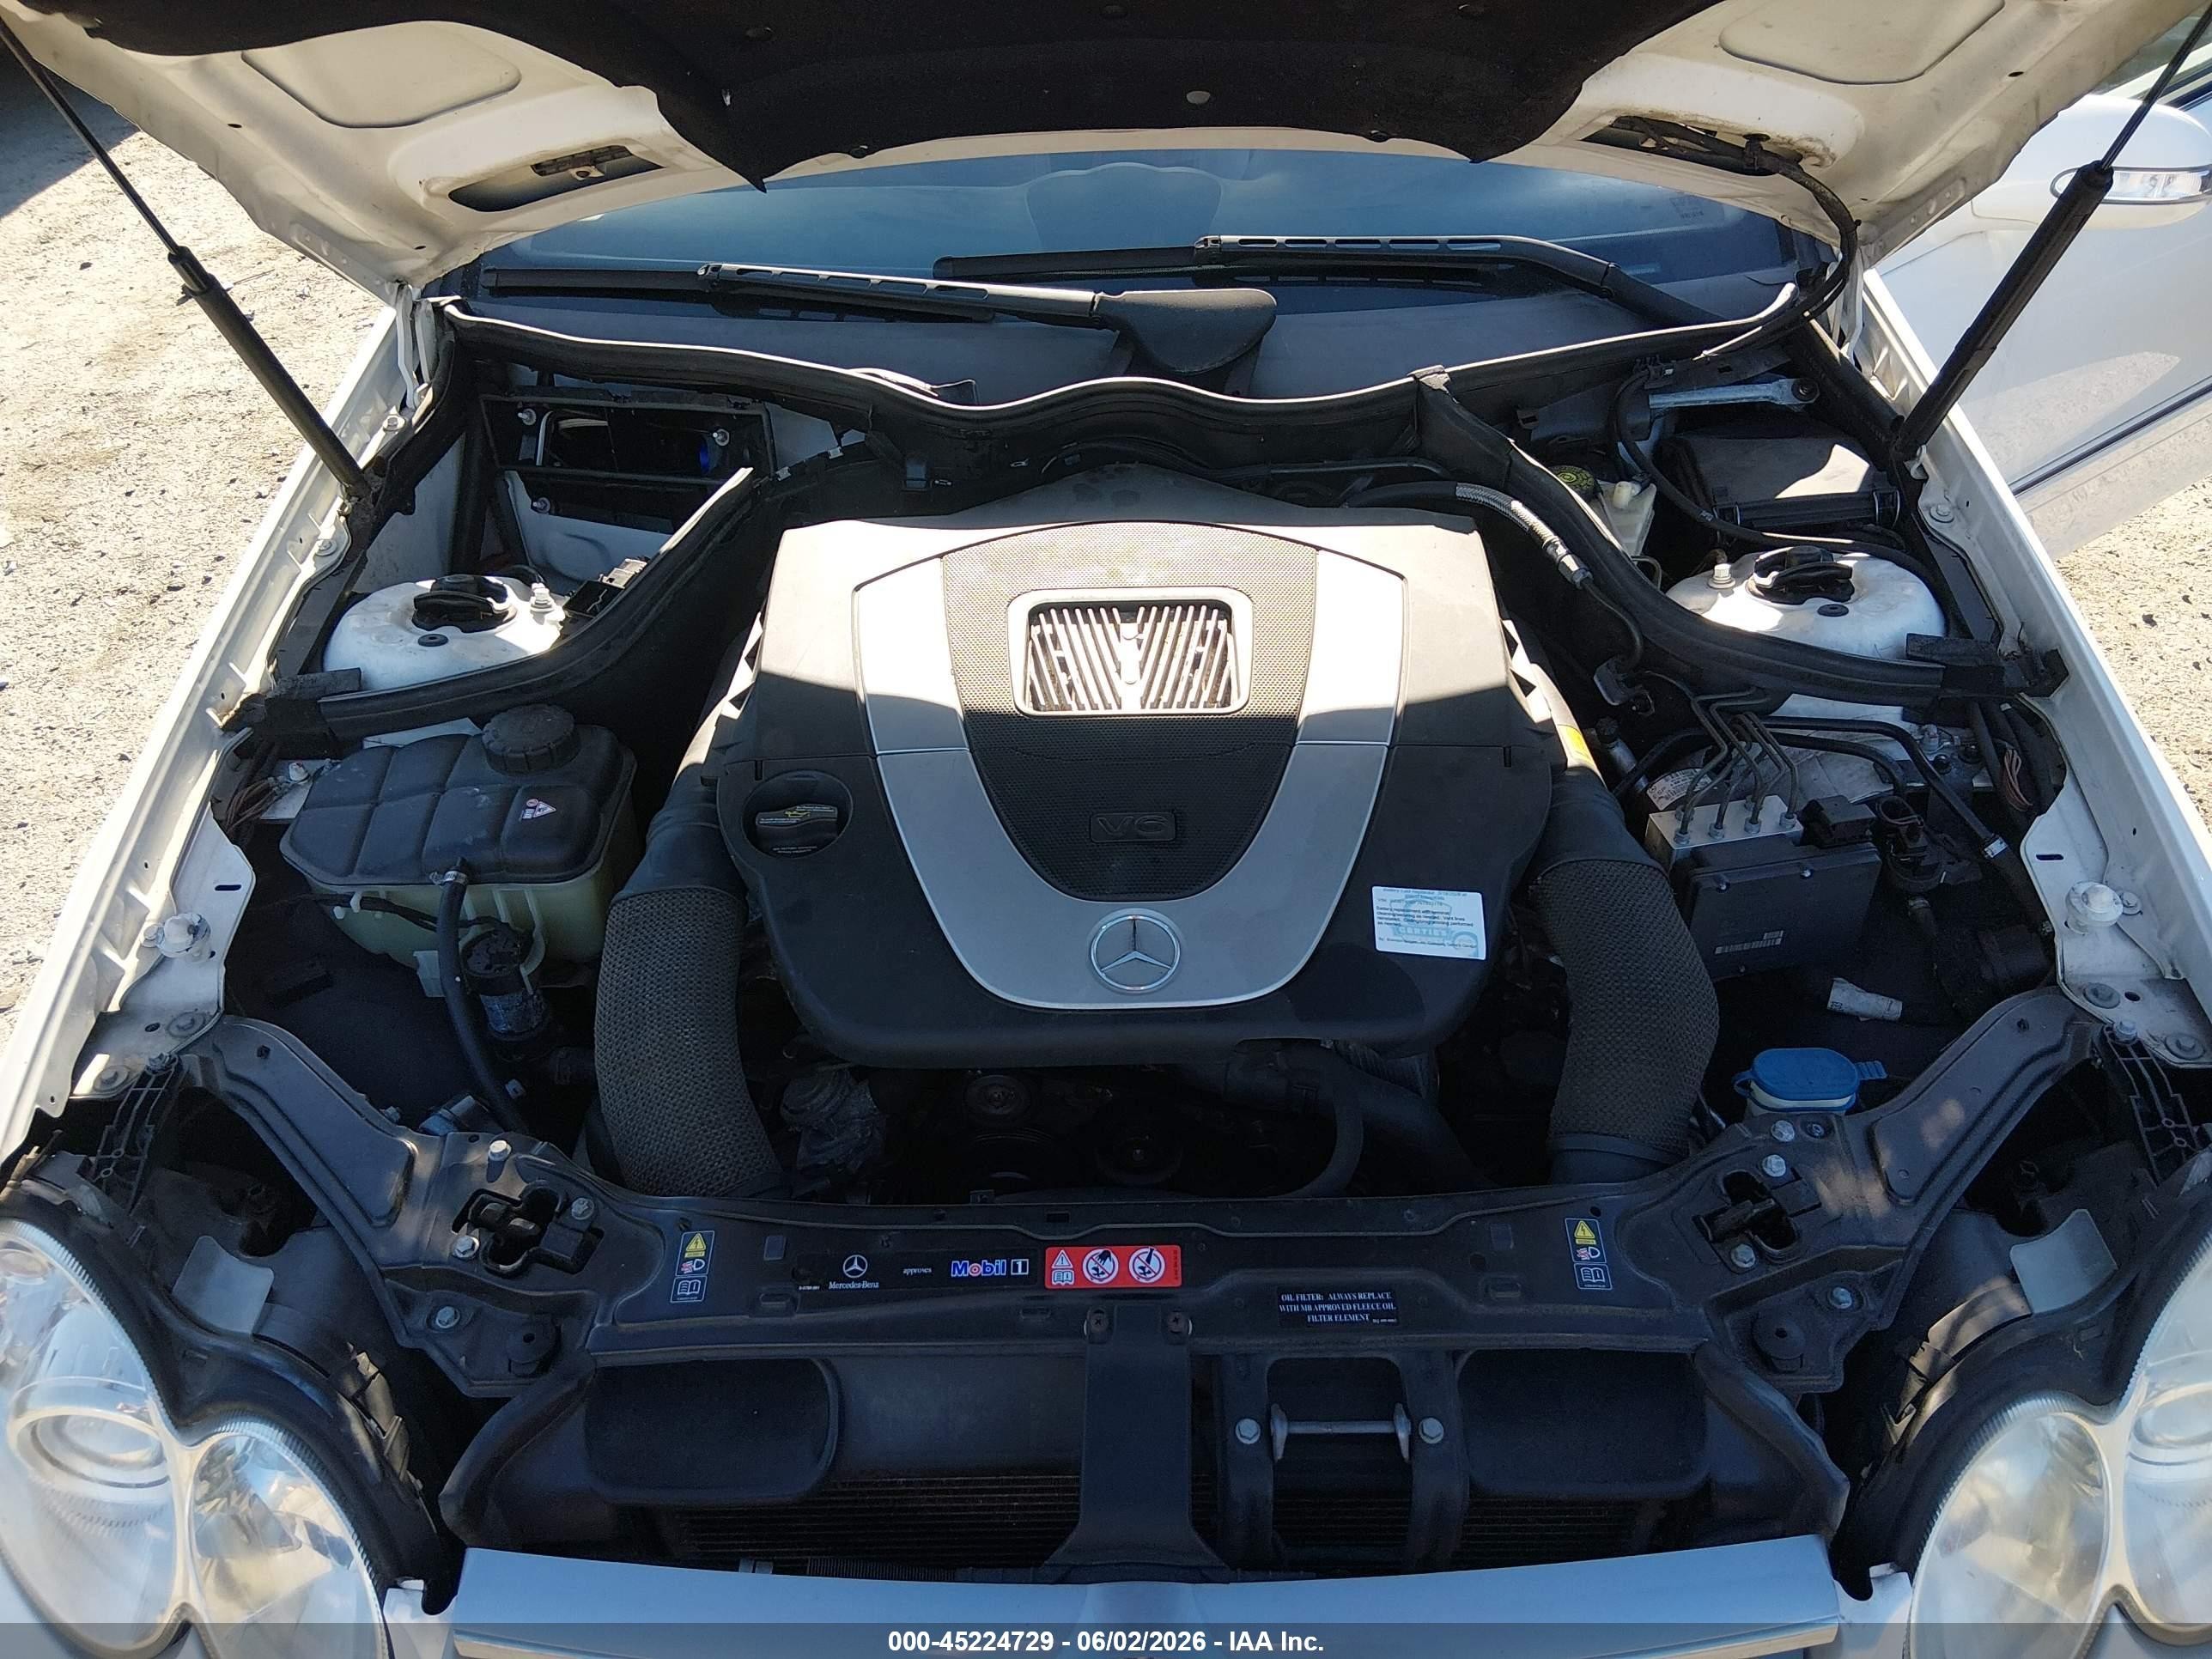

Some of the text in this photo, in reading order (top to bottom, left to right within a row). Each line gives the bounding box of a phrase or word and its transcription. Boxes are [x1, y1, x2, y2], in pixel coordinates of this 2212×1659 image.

[1097, 815, 1169, 837] V6
[829, 1281, 879, 1290] Mercedes-Benz
[902, 1267, 932, 1275] approves
[951, 1260, 1006, 1277] Mobil
[1281, 1292, 1392, 1301] OIL FILTER: ALWAYS REPLACE
[1313, 1304, 1352, 1312] APPROVED
[1307, 1314, 1333, 1322] FILTER
[1334, 1313, 1370, 1322] ELEMENT
